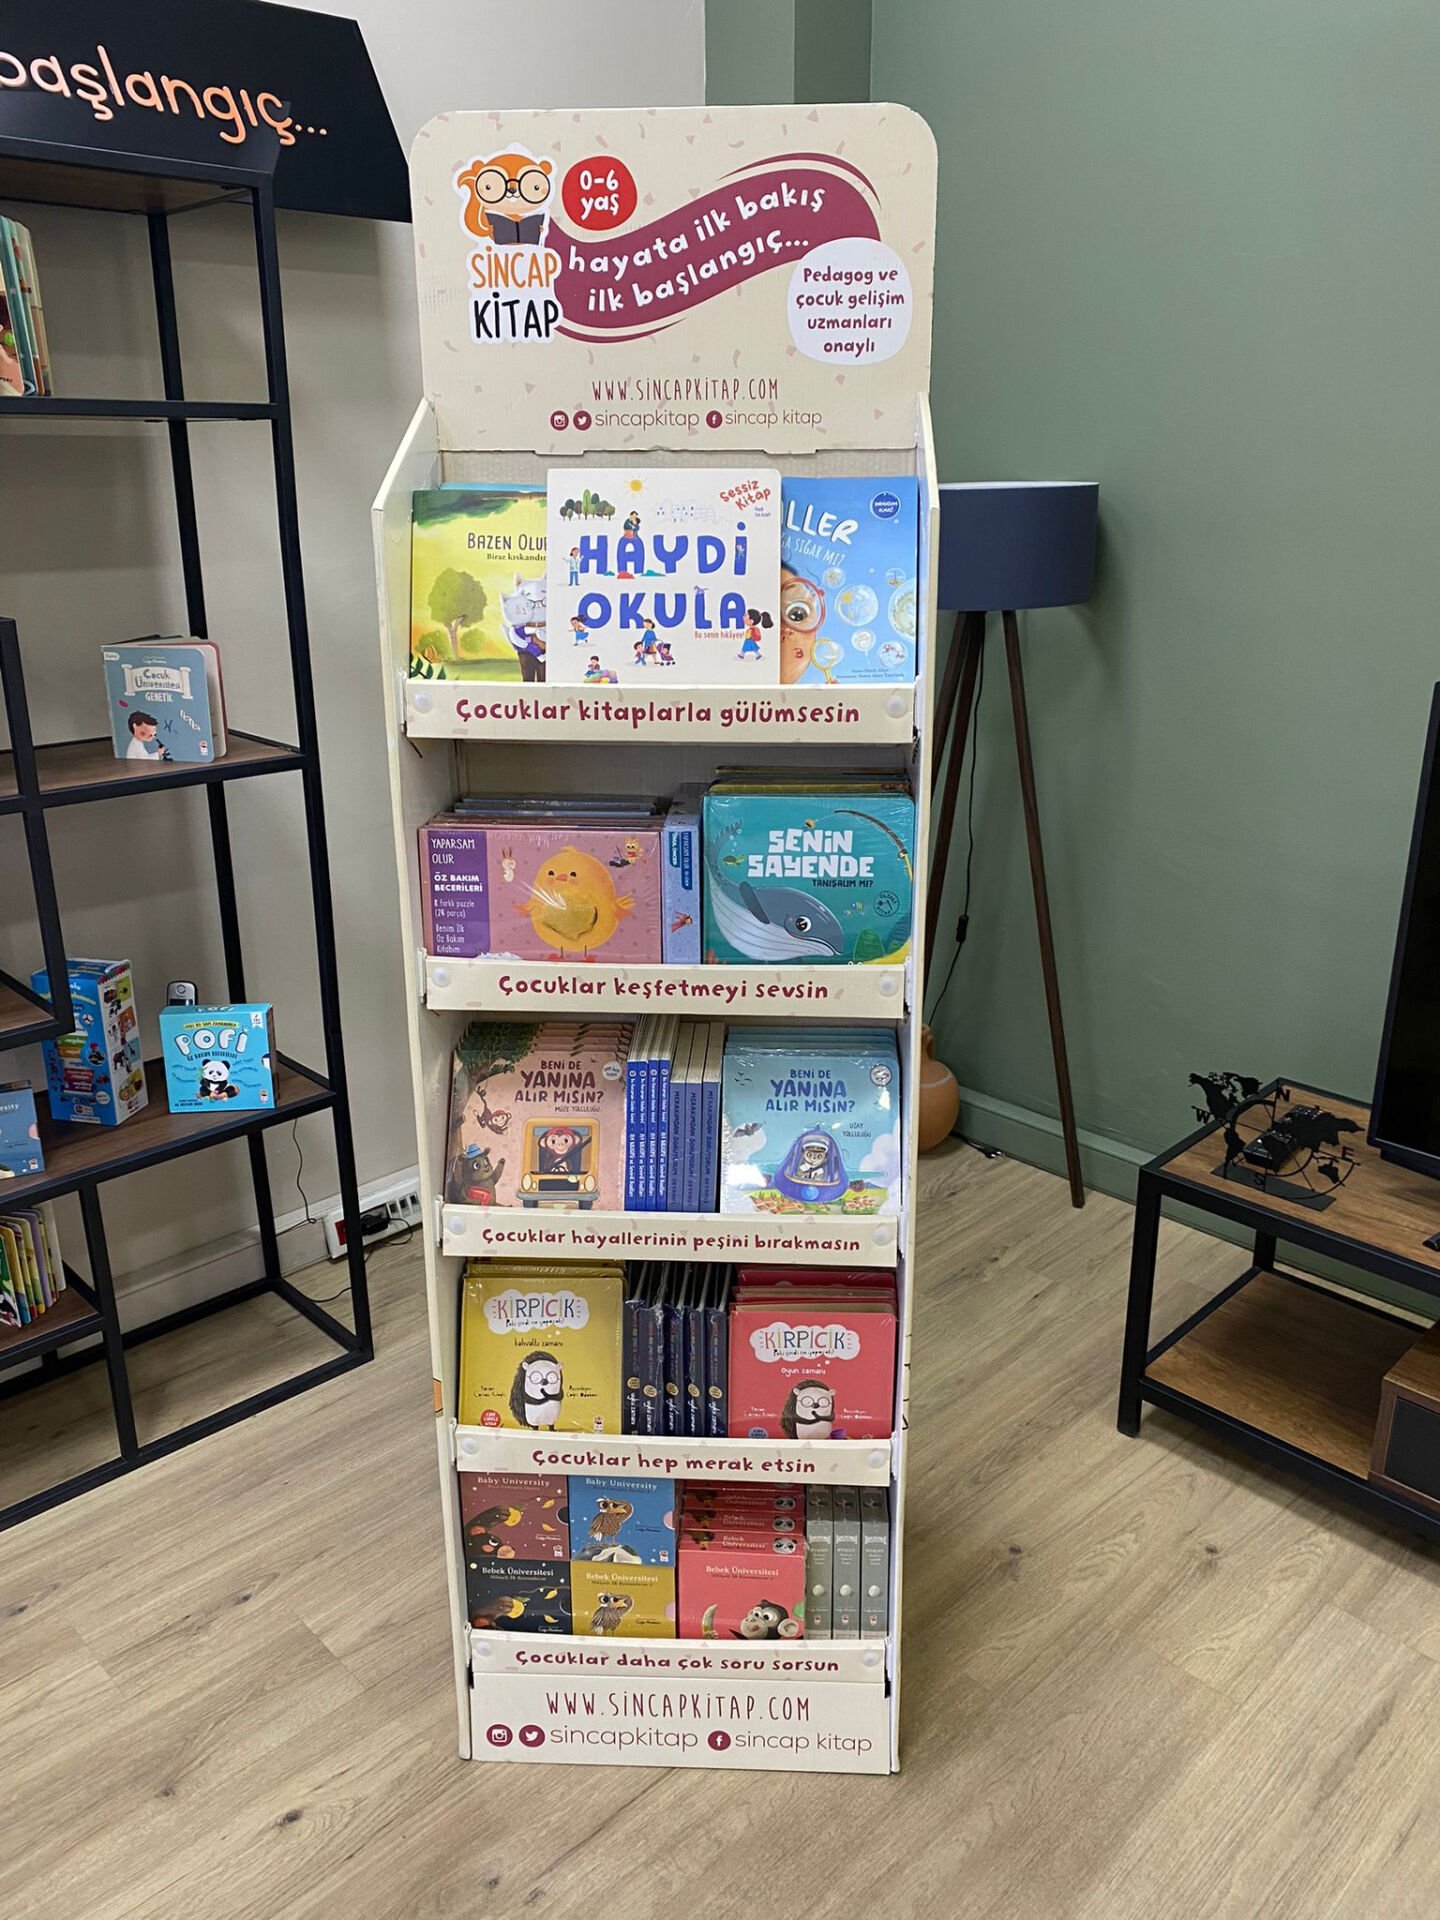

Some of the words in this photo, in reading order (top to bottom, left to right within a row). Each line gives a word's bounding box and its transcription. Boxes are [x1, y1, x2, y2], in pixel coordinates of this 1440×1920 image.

[580, 170, 619, 191] 0-6
[580, 195, 620, 220] yaş
[568, 235, 688, 283] hayata
[695, 211, 731, 243] ilk
[736, 183, 826, 217] bakış
[470, 244, 559, 289] SİNCAP
[588, 289, 624, 313] ilk
[634, 229, 809, 307] başlangıç...
[803, 267, 873, 286] Pedagog
[878, 268, 899, 281] ve
[796, 292, 844, 311] çocuk
[848, 292, 905, 309] gelişim
[474, 291, 560, 339] KİTAP
[807, 314, 892, 331] uzmanları
[823, 338, 876, 358] onaylı
[595, 410, 700, 431] sincapkitap
[725, 411, 778, 431] sincap
[782, 410, 823, 429] kitap
[719, 480, 760, 502] Sessiz
[735, 488, 771, 511] Kitap
[781, 500, 859, 545] LLER
[468, 532, 512, 550] BAZEN
[579, 521, 747, 576] HAYDİ
[577, 592, 746, 630] OKULA
[456, 699, 571, 722] Çocuklar
[578, 700, 711, 729] kitaplarla
[720, 700, 860, 728] gülümsesin
[431, 838, 475, 849] YAPARSAM
[768, 829, 853, 853] SENİN
[432, 853, 455, 864] OLUR
[747, 855, 874, 877] SAYENDE
[434, 871, 447, 882] ÖZ
[450, 874, 480, 882] BAKIM
[812, 879, 856, 888] TANIŞALIM
[859, 880, 874, 888] MI?
[434, 882, 483, 892] BECERİLERİ
[498, 975, 605, 1000] Çocuklar
[614, 978, 747, 1004] keşfetmeyi
[756, 981, 828, 999] sevsin
[540, 1060, 565, 1070] BENİ
[568, 1061, 581, 1070] DE
[790, 1070, 815, 1078] BENİ
[818, 1070, 830, 1078] DE
[521, 1070, 596, 1089] YANINA
[770, 1080, 847, 1098] YANINA
[514, 1091, 548, 1103] ALIR
[553, 1092, 604, 1104] MISIN?
[766, 1100, 798, 1111] ALIR
[805, 1100, 855, 1113] MISIN?
[482, 1229, 566, 1250] Çocuklar
[572, 1230, 687, 1249] hayallerinin
[694, 1234, 748, 1251] peşini
[755, 1235, 860, 1251] bırakmasın
[514, 1338, 541, 1347] kahvaltı
[781, 1367, 799, 1378] oyun
[532, 1451, 631, 1469] Çocuklar
[638, 1454, 678, 1473] hep
[686, 1458, 753, 1471] merak
[761, 1458, 815, 1473] etsin
[477, 1477, 498, 1485] Baby
[502, 1478, 550, 1487] University
[586, 1478, 607, 1487] Baby
[610, 1480, 658, 1491] University
[507, 1567, 554, 1576] Üniversitesi
[611, 1573, 658, 1582] Üniversitesi
[732, 1566, 779, 1576] Üniversitesi
[515, 1650, 609, 1666] Çocuklar
[617, 1653, 670, 1668] daha
[678, 1655, 713, 1672] çok
[721, 1658, 765, 1671] soru
[772, 1659, 840, 1672] sorsun
[550, 1726, 698, 1749] sincapkitap
[735, 1731, 809, 1753] sincap
[817, 1732, 872, 1756] kitap
